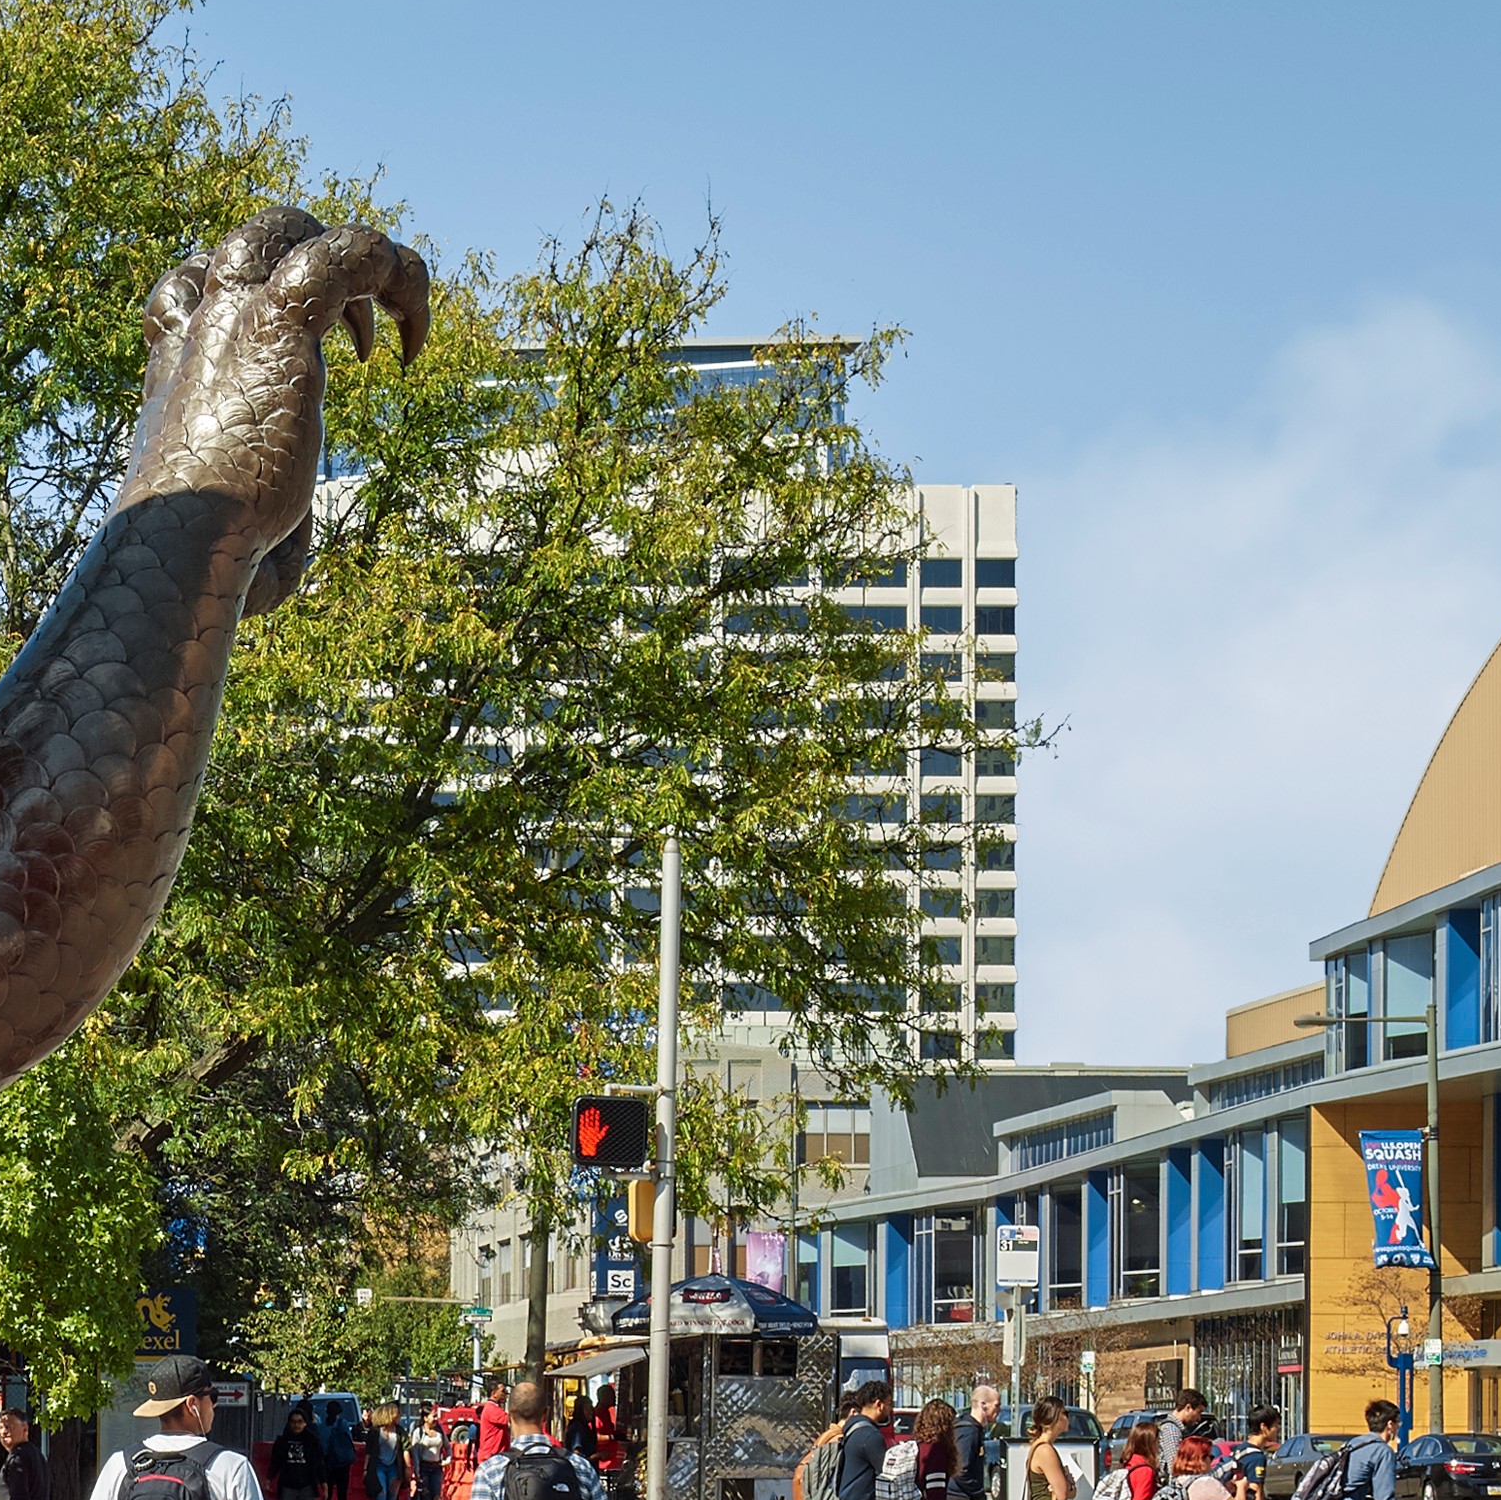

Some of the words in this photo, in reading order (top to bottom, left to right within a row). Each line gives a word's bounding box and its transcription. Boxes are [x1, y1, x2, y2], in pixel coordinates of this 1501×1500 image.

[1365, 1149, 1421, 1160] SQUASH
[1388, 1164, 1421, 1172] UNIVERSITY
[1000, 1240, 1013, 1251] 31
[611, 1274, 632, 1288] Sc
[138, 1329, 180, 1349] exel
